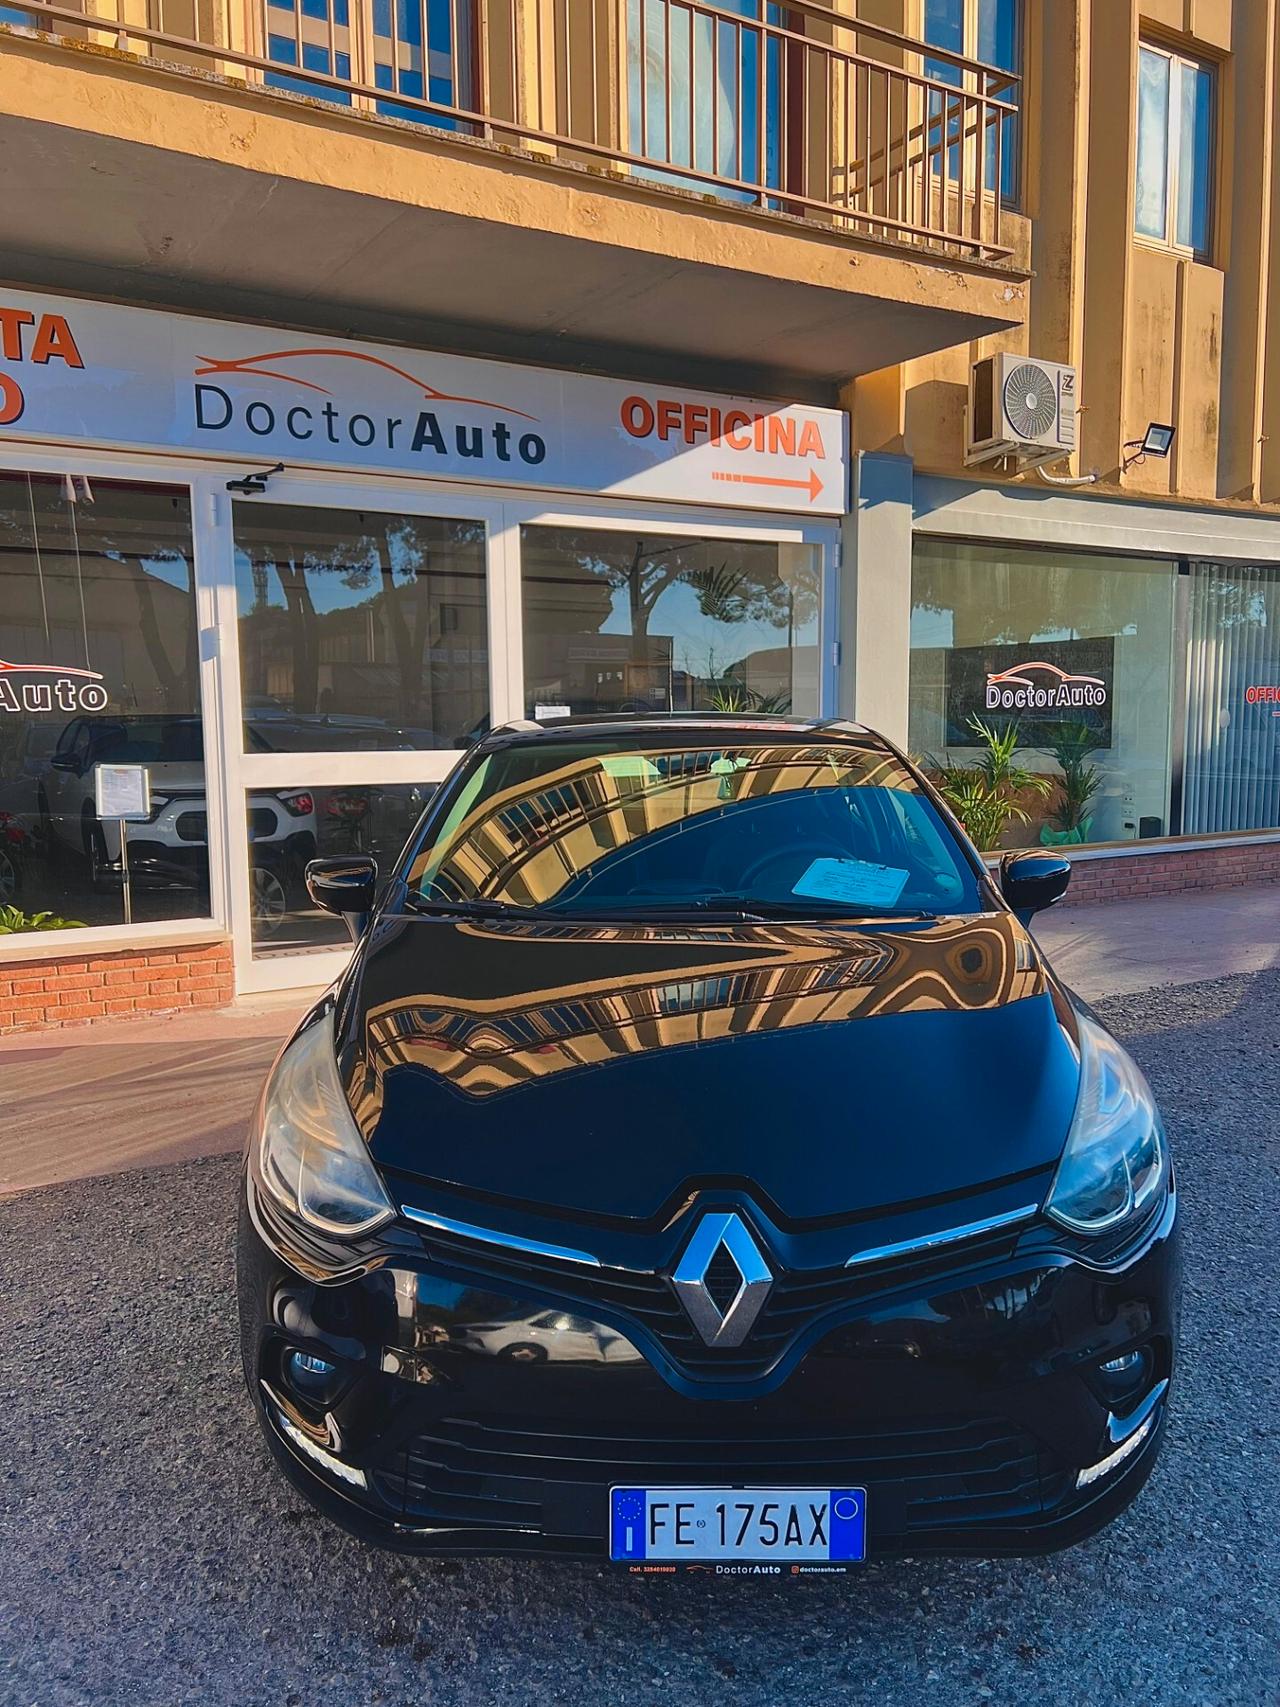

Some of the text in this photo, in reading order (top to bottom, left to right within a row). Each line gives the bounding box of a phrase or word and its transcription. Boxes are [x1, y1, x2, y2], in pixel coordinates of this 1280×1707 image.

[195, 384, 547, 465] DoctorAuto
[620, 395, 826, 460] OFFICINA
[985, 684, 1106, 709] DoctorAuto
[649, 1503, 828, 1546] FE 175AX
[716, 1565, 781, 1575] DoctorAuto
